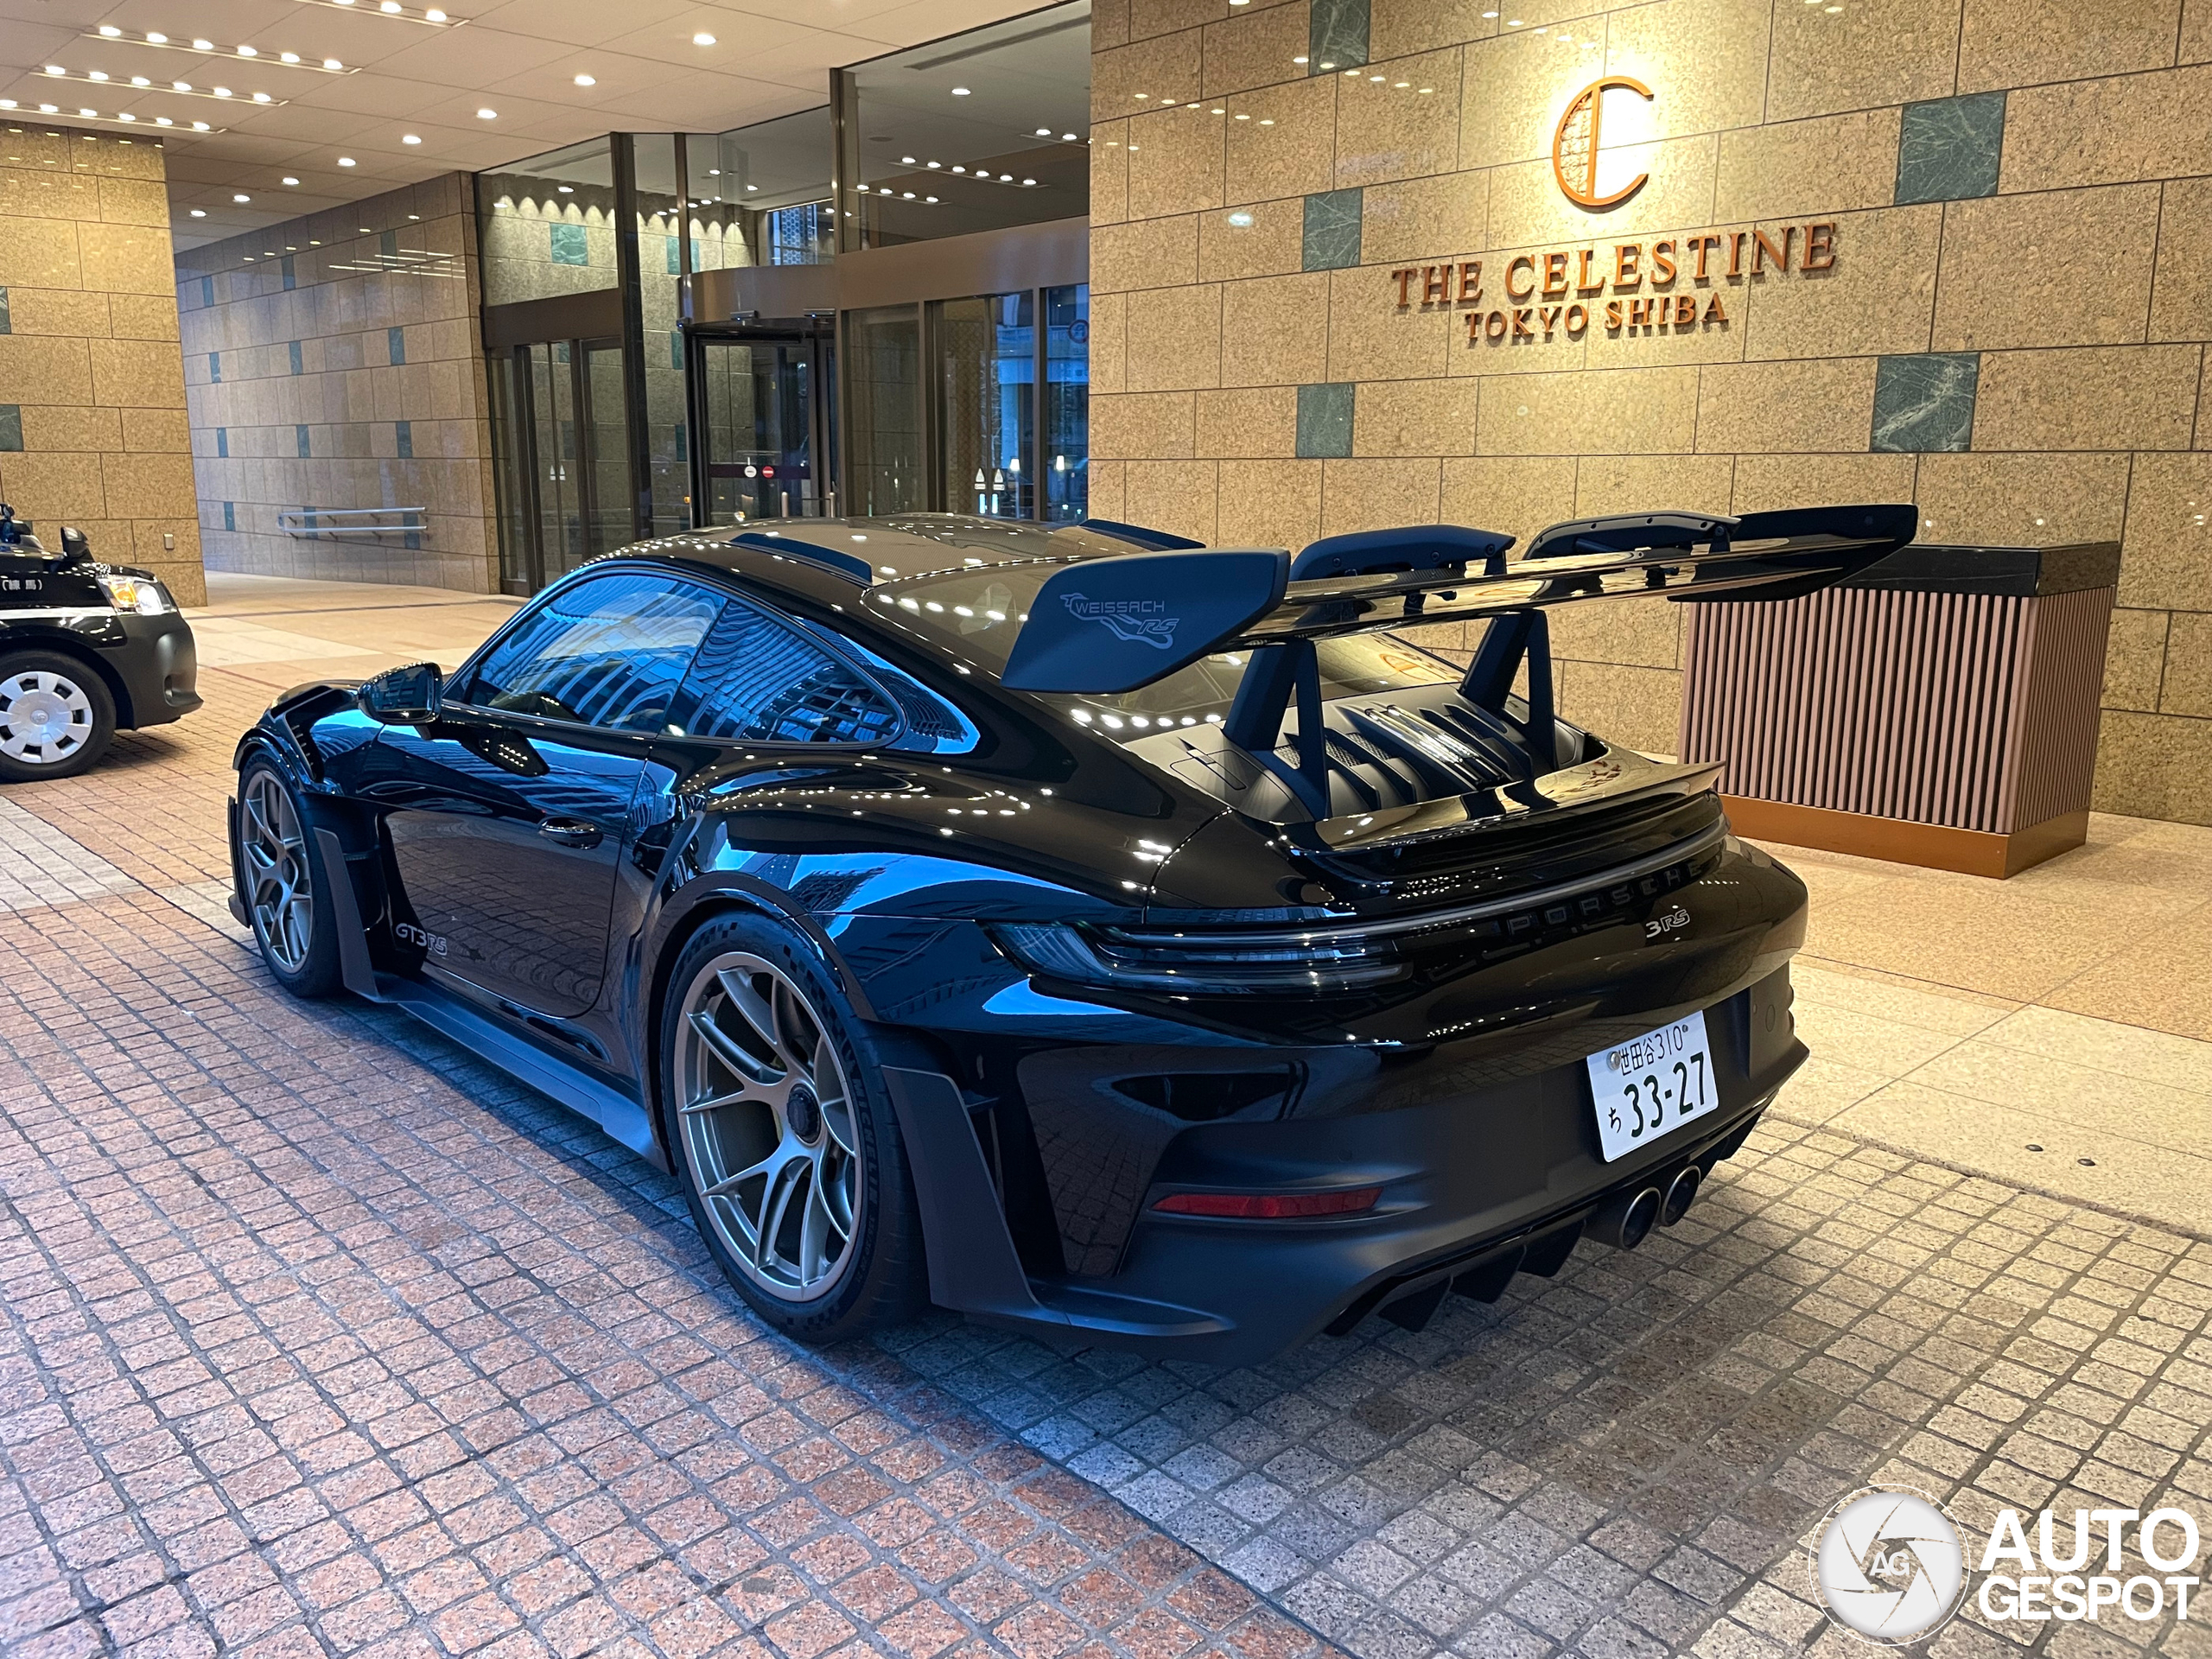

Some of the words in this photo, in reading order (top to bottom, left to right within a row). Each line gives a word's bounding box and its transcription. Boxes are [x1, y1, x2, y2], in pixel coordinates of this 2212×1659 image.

[1391, 261, 1484, 308] THE
[1504, 221, 1839, 298] CELESTINE
[1465, 303, 1588, 339] TOKYO
[1605, 292, 1727, 330] SHIBA
[1075, 600, 1165, 614] WEISSACH
[1136, 618, 1179, 635] RS
[1507, 862, 1702, 936] PORSCHE
[1608, 1106, 1622, 1134] ち
[1624, 1051, 1704, 1139] 33-27
[851, 1077, 879, 1208] MICHELIN
